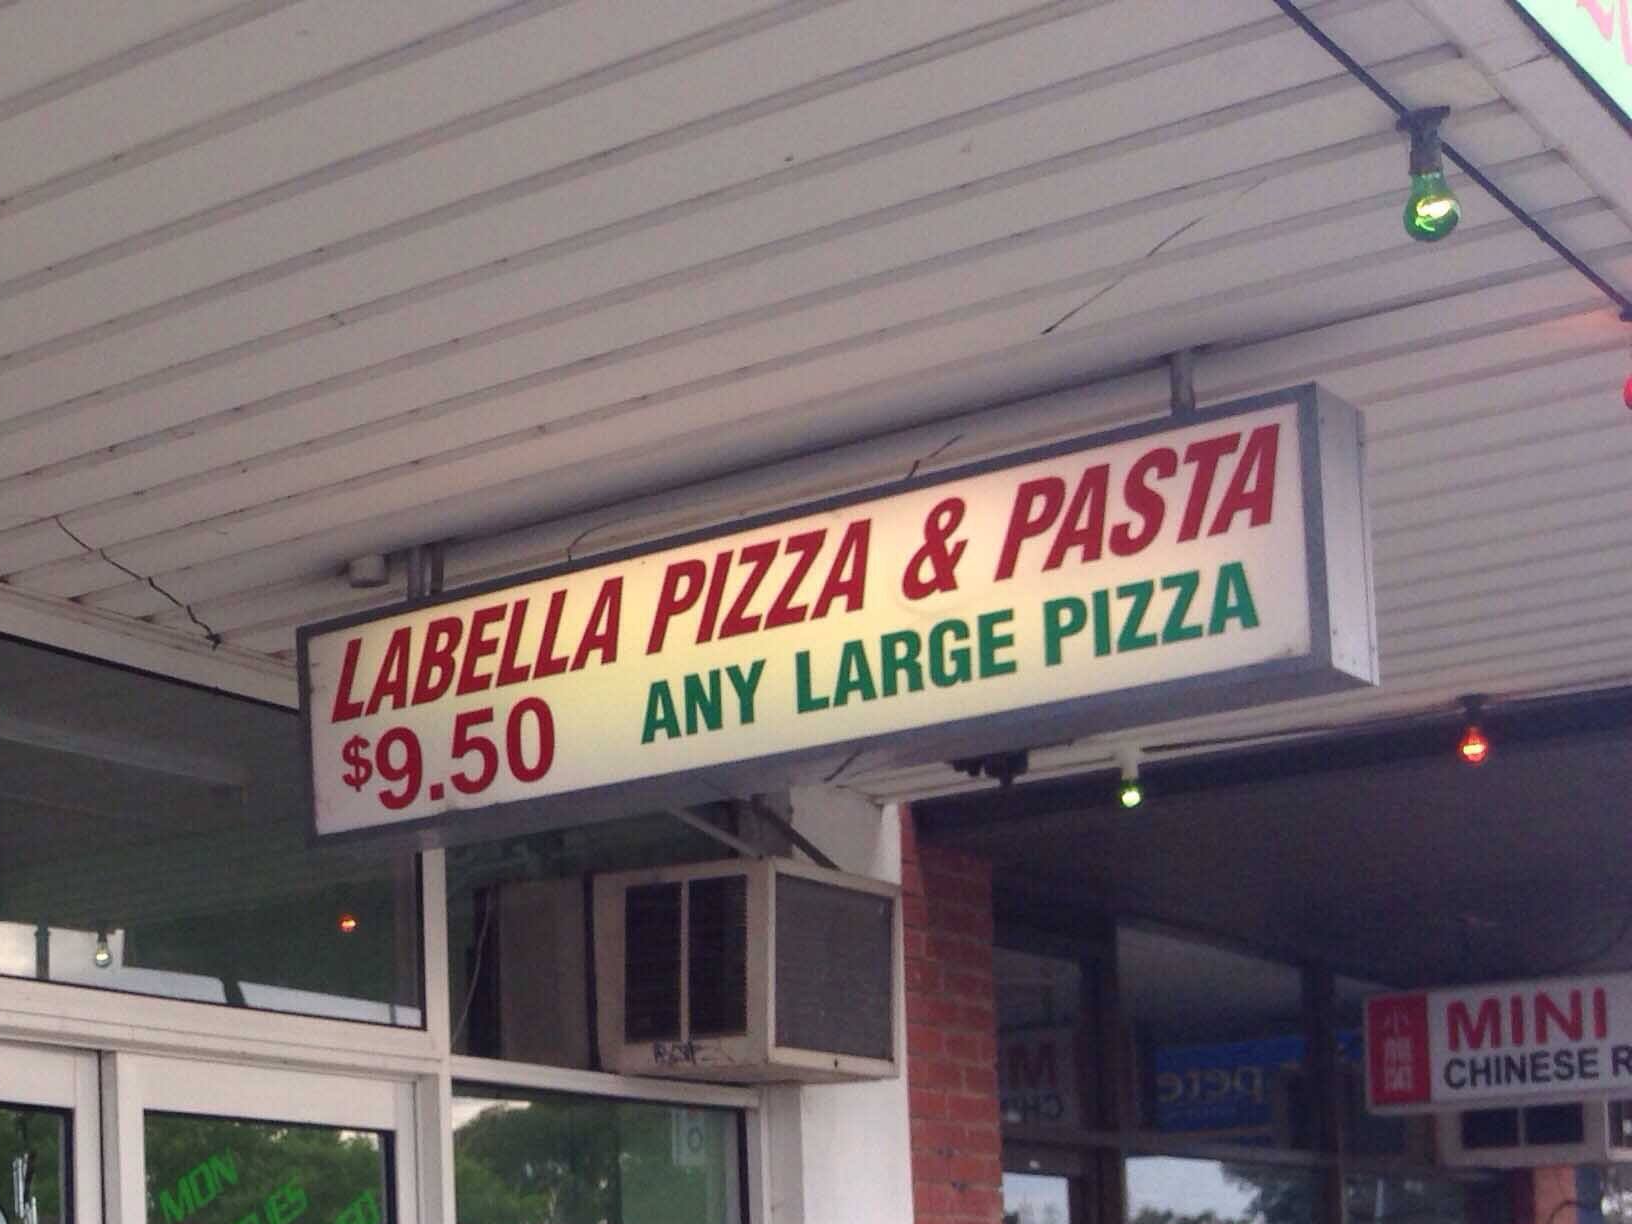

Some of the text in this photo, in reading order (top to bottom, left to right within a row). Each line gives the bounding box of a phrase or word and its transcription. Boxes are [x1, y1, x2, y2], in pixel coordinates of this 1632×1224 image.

[332, 422, 1281, 724] LABELLA PIZZA & PASTA
[340, 561, 1260, 811] $9.50 ANY LARGE PIZZA
[1443, 1046, 1600, 1089] CHINESE
[1446, 986, 1609, 1053] MINI
